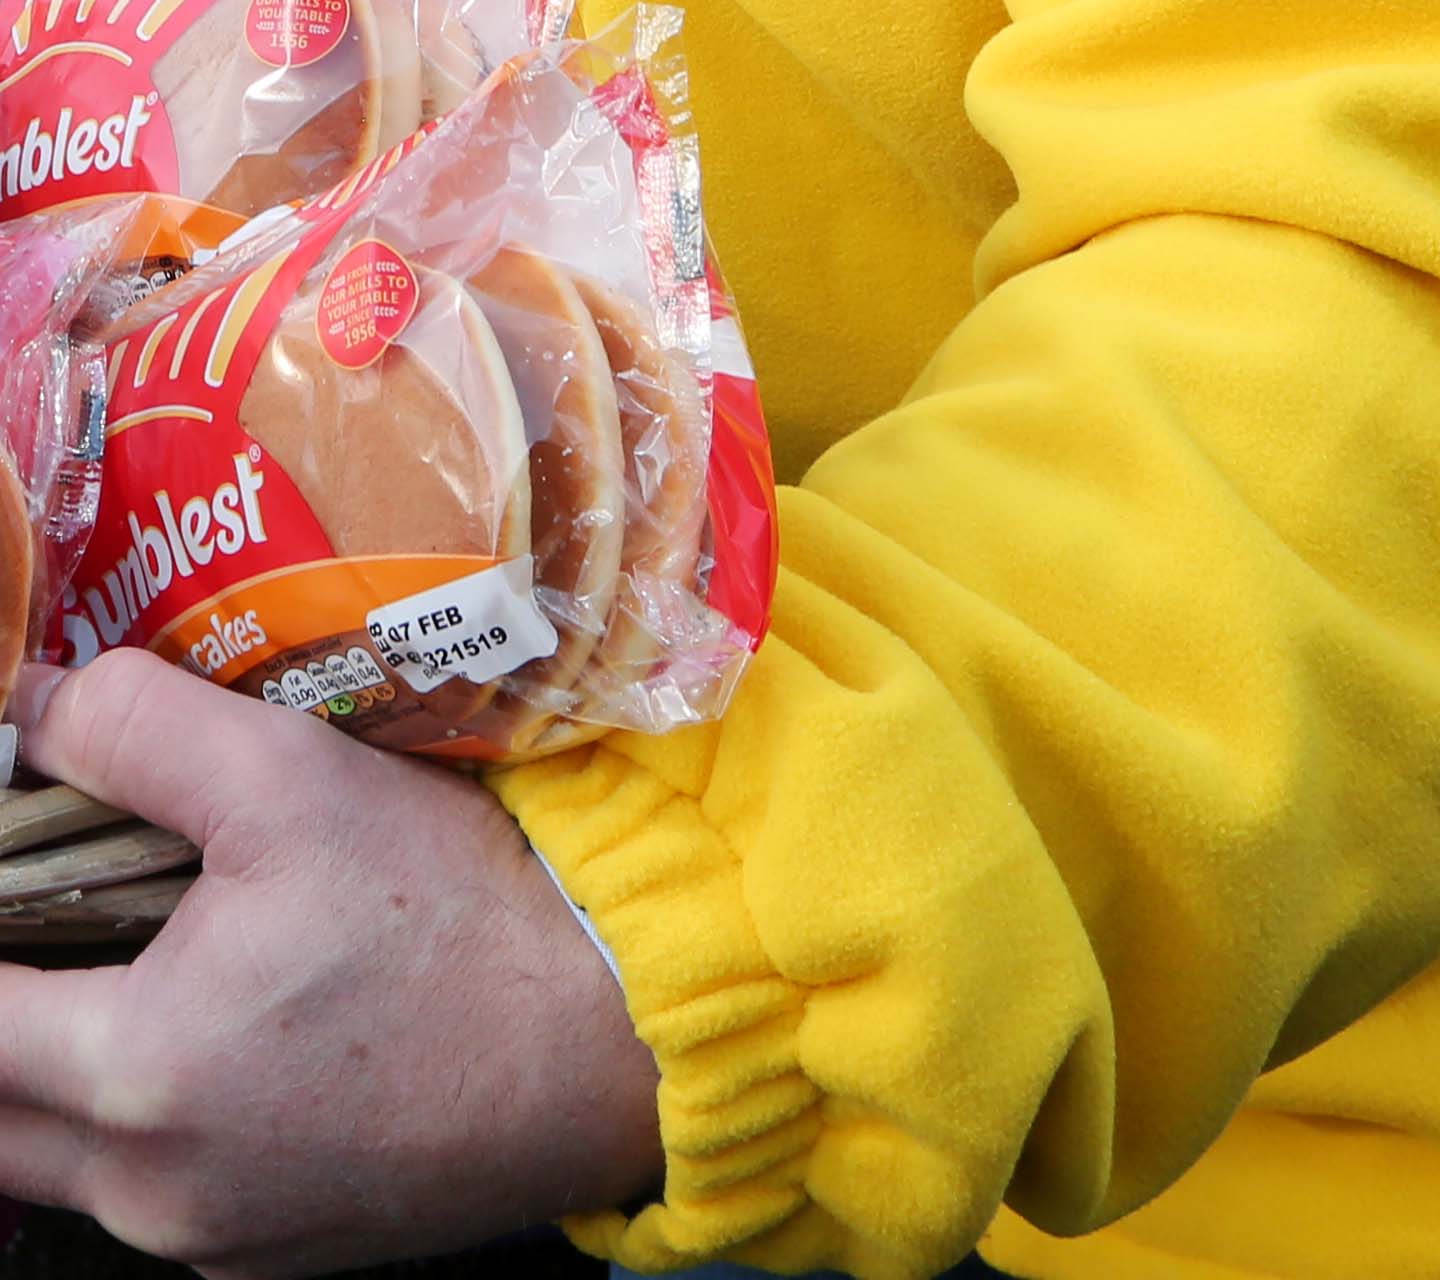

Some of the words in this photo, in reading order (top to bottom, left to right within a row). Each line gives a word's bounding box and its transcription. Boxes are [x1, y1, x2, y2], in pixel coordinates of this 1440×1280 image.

[294, 8, 333, 24] TABLE
[324, 0, 342, 11] TO
[322, 288, 346, 309] OUR
[387, 275, 408, 289] TO
[328, 298, 357, 321] YOUR
[360, 291, 399, 308] TABLE
[345, 319, 377, 349] 1956
[388, 622, 411, 643] 07
[417, 605, 464, 637] FEB
[182, 608, 267, 676] cakes
